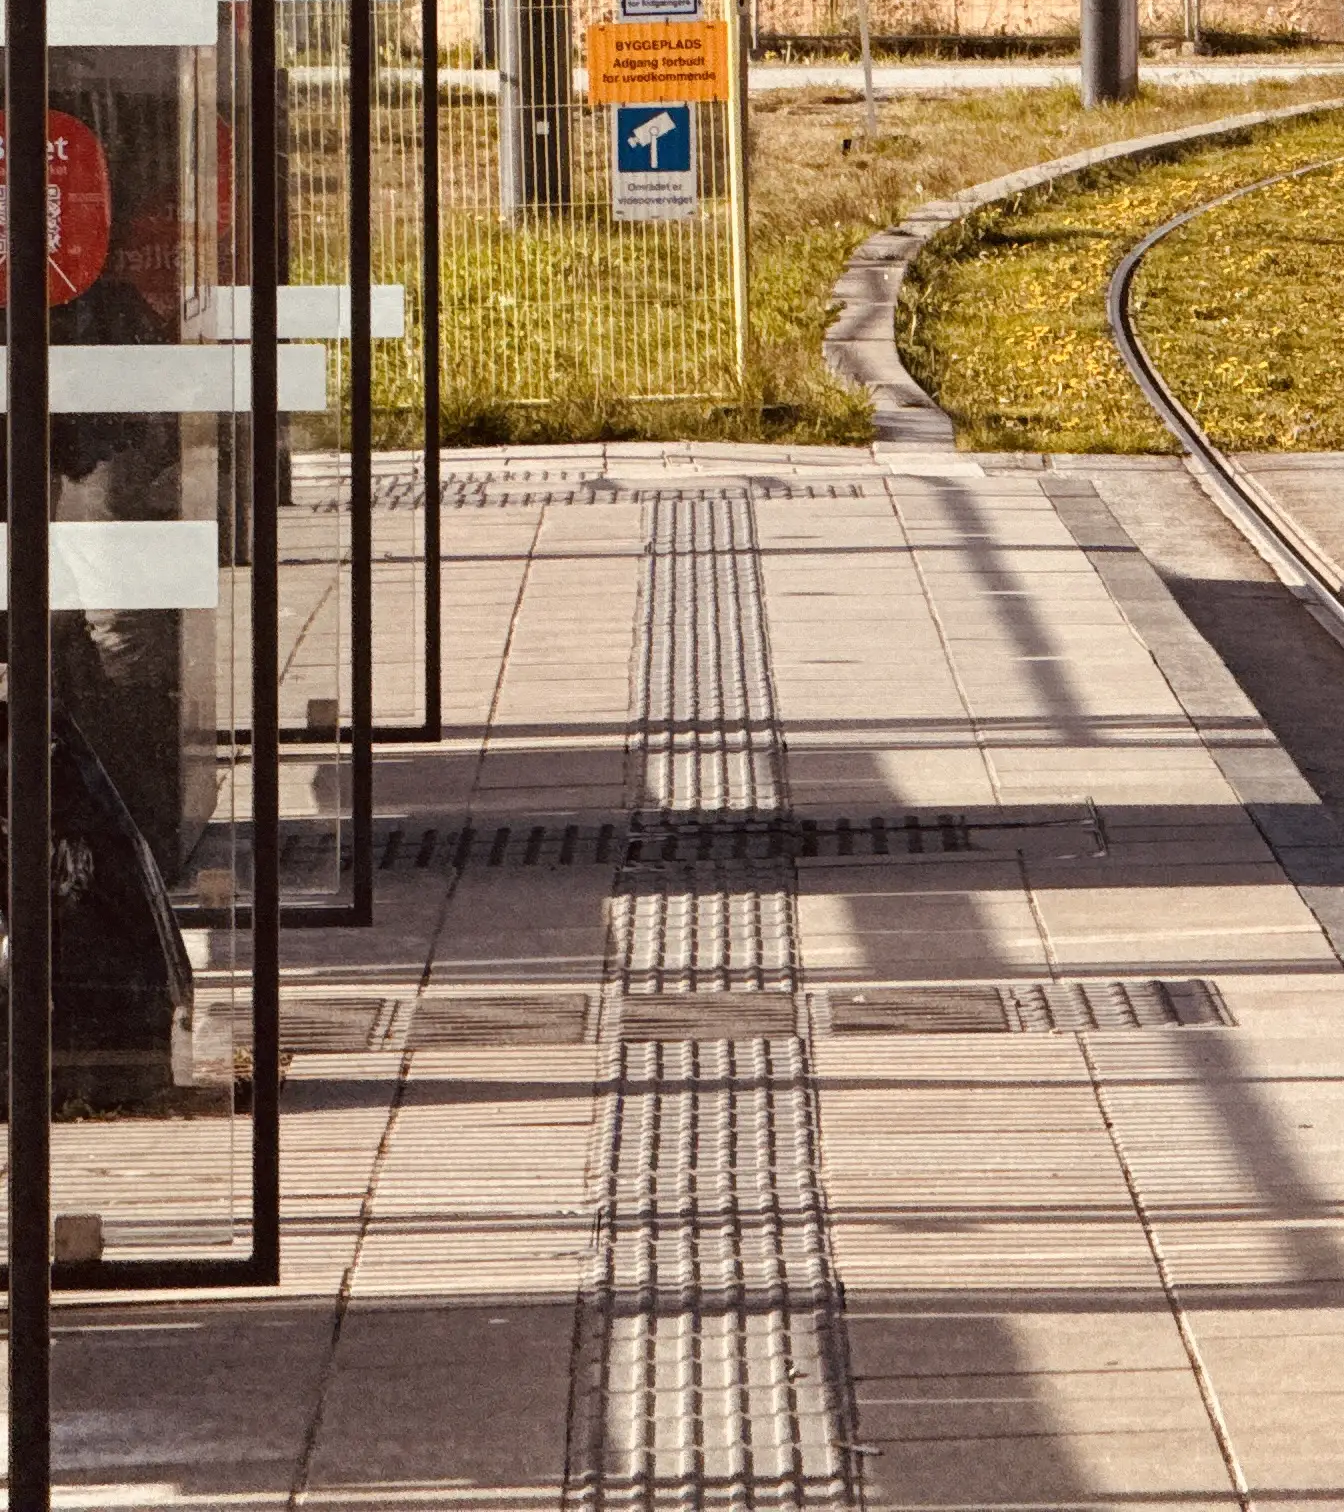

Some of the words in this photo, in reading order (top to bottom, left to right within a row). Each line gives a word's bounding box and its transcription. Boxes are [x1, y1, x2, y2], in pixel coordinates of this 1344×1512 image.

[615, 39, 702, 51] BYGGEPLADS
[612, 57, 659, 70] Adgang
[662, 55, 705, 67] forbudt
[602, 73, 620, 84] for
[622, 70, 717, 83] uvedkommende
